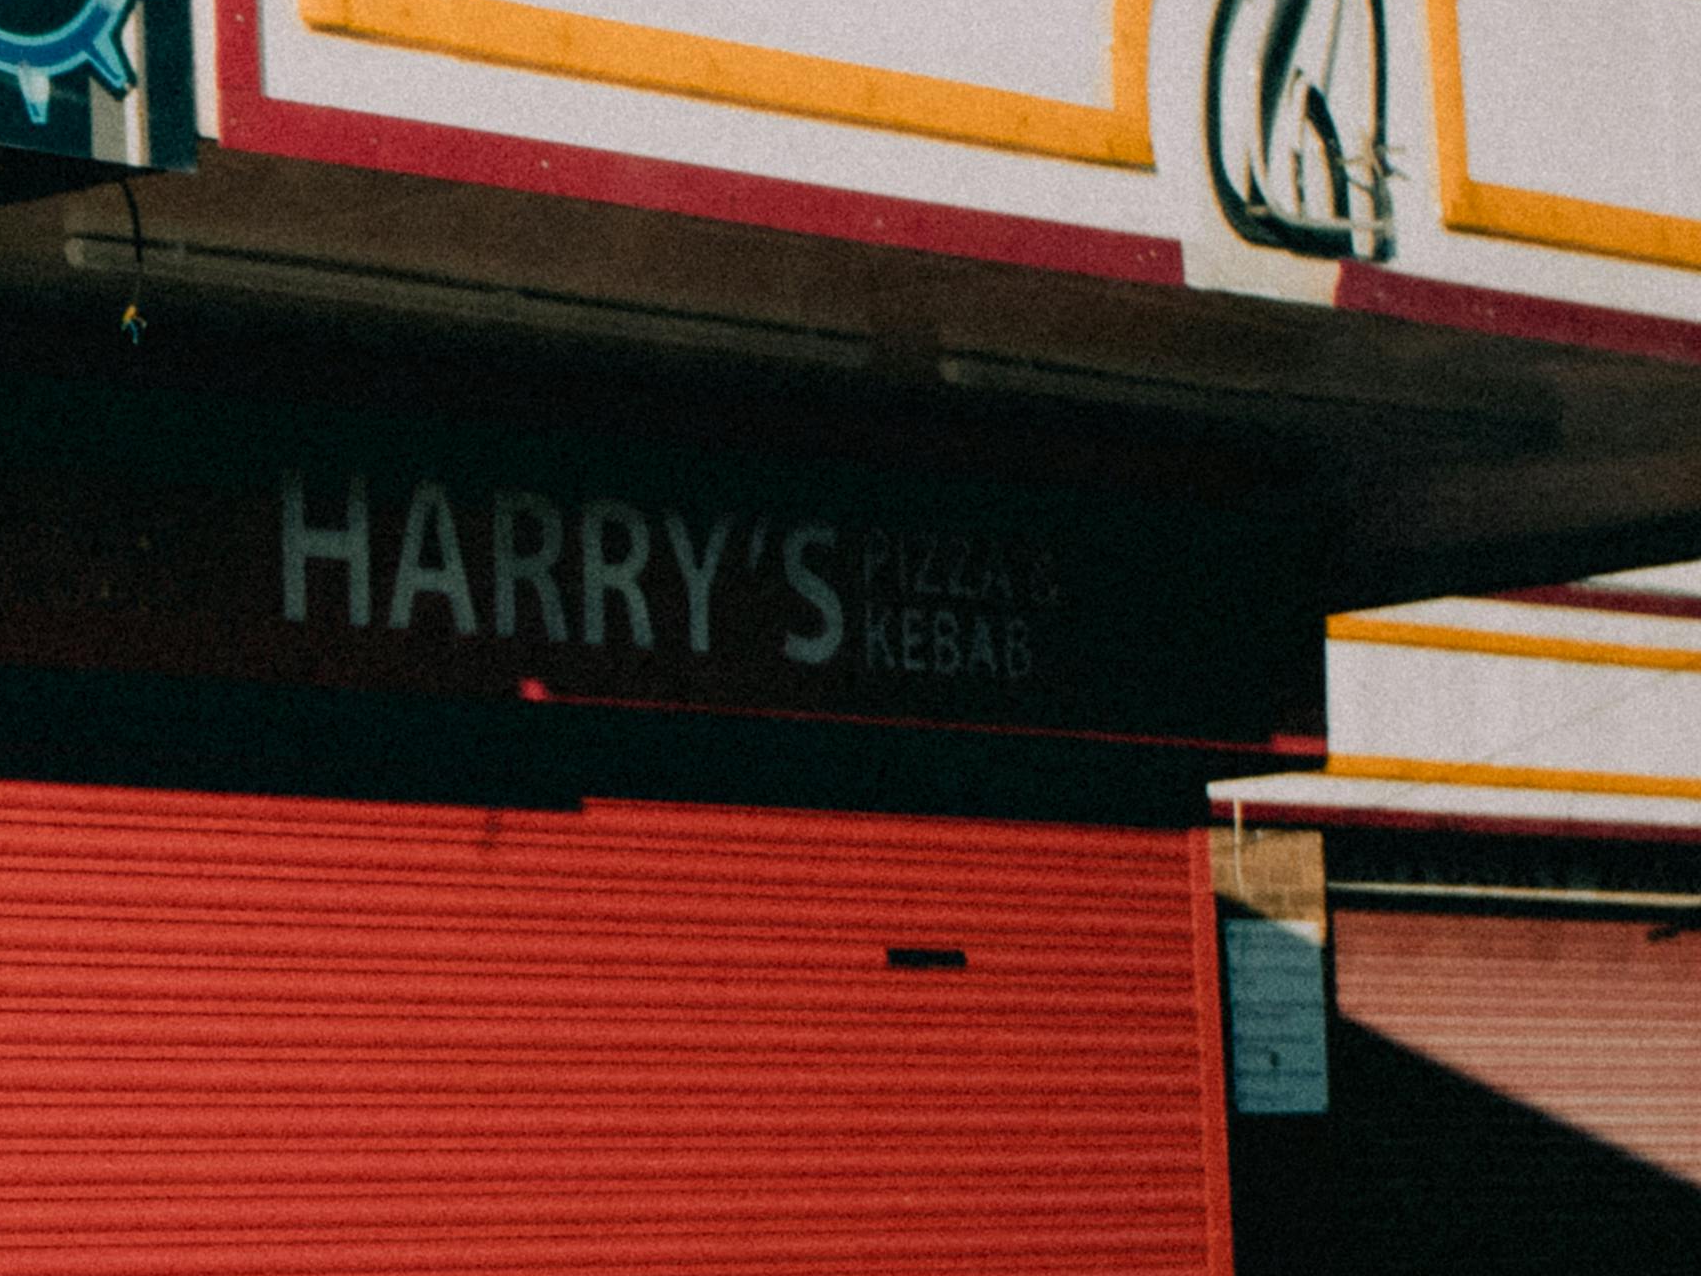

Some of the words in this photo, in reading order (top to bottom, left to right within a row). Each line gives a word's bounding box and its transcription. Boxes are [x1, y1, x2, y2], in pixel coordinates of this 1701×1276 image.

[280, 466, 845, 665] HARRY'S
[861, 526, 1013, 600] PIZZA
[861, 602, 1034, 680] KEBAB
